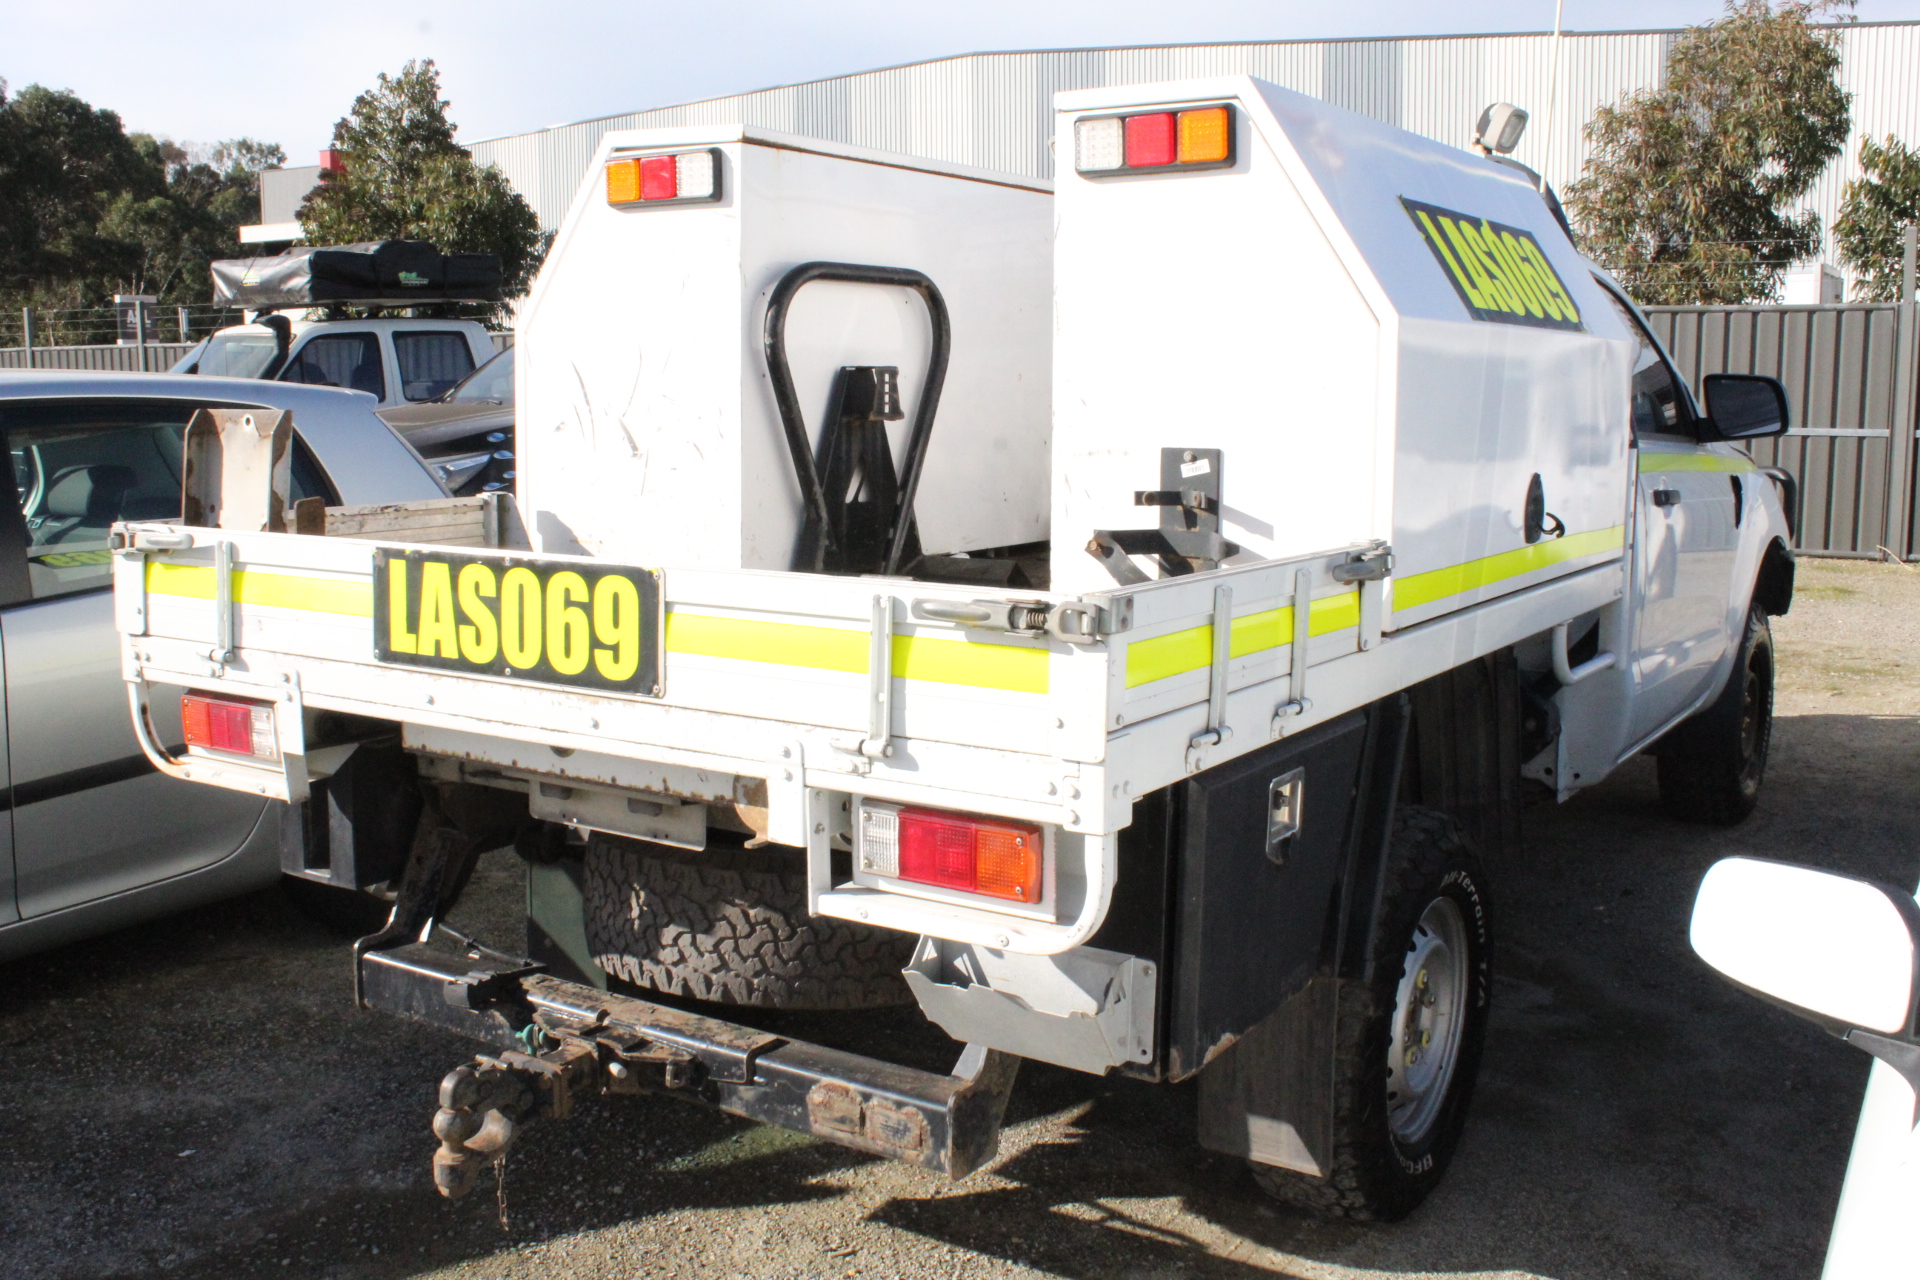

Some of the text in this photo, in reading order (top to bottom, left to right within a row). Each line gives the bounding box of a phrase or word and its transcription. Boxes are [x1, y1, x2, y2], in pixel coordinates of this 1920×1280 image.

[127, 309, 151, 324] AL
[1416, 210, 1579, 323] LAS069
[388, 558, 639, 681] LAS069
